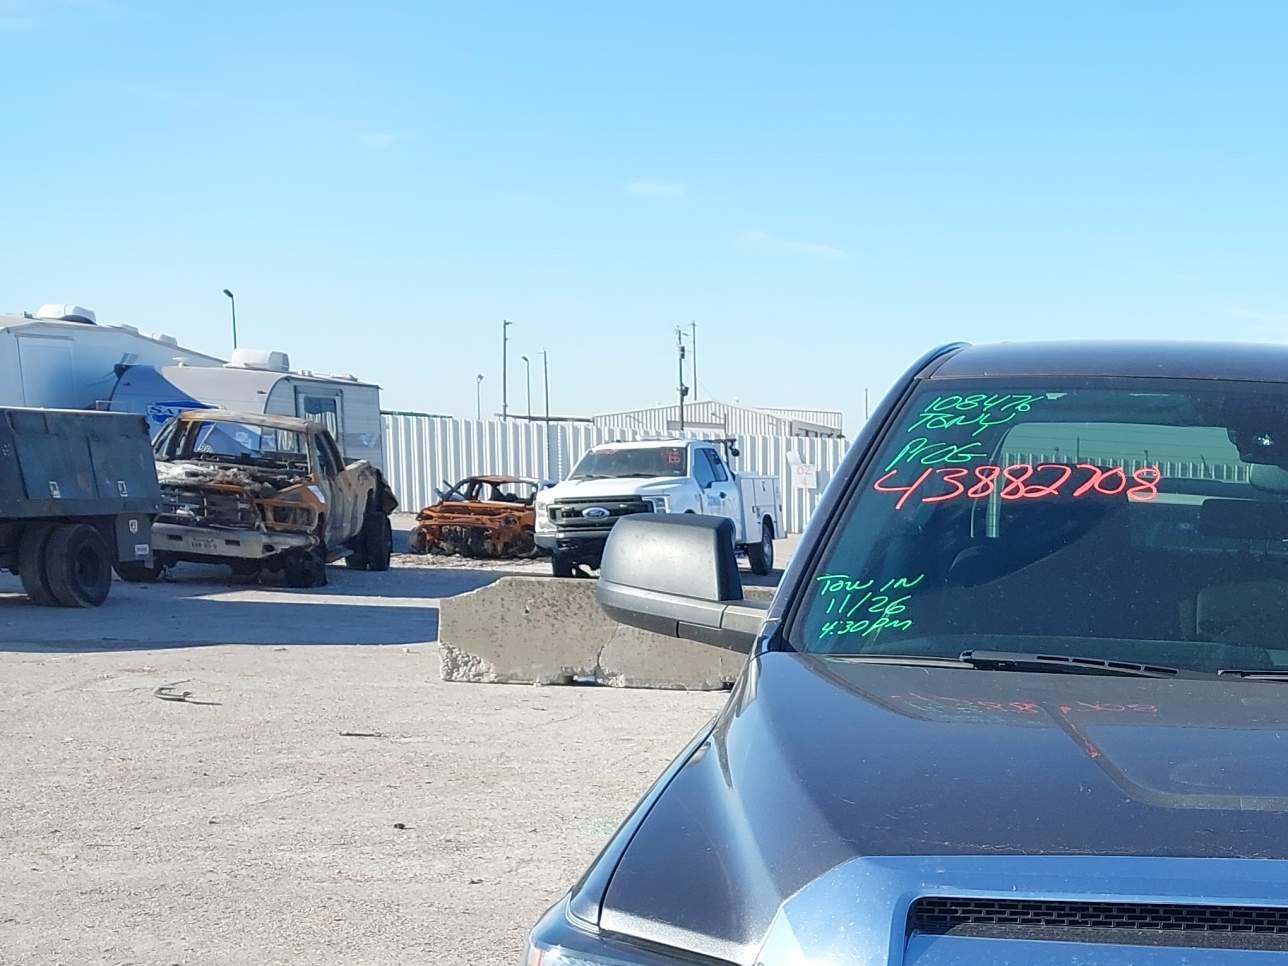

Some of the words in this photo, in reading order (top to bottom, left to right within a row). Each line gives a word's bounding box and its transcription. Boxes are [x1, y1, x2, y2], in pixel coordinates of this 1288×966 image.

[924, 394, 1044, 413] 108476
[874, 464, 1160, 509] 43882708
[826, 592, 912, 617] 11/26
